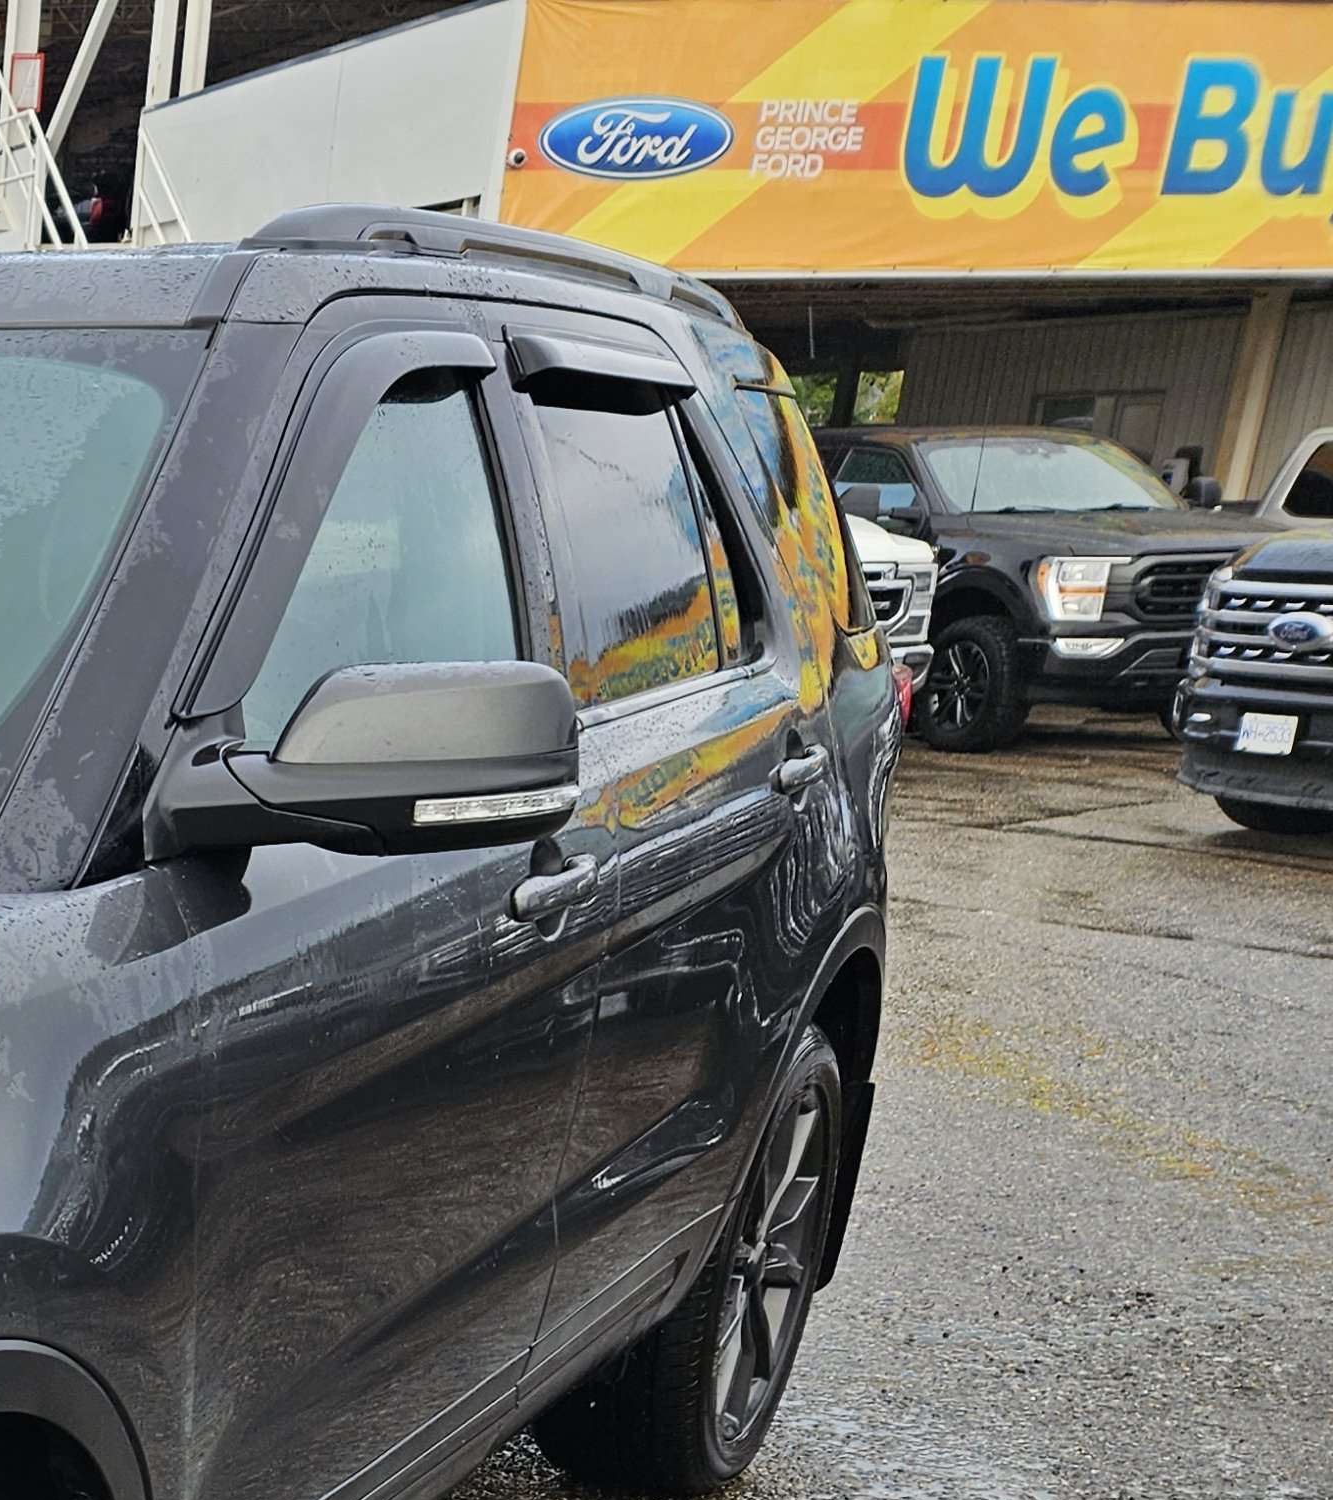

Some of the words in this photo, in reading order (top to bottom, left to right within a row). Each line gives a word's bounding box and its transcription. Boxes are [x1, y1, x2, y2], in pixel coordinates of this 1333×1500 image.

[760, 99, 859, 125] PRINCE
[577, 108, 699, 168] Ford
[755, 125, 865, 151] GEORGE
[904, 55, 1126, 198] We
[1160, 57, 1333, 198] Bu
[749, 153, 824, 179] FORD
